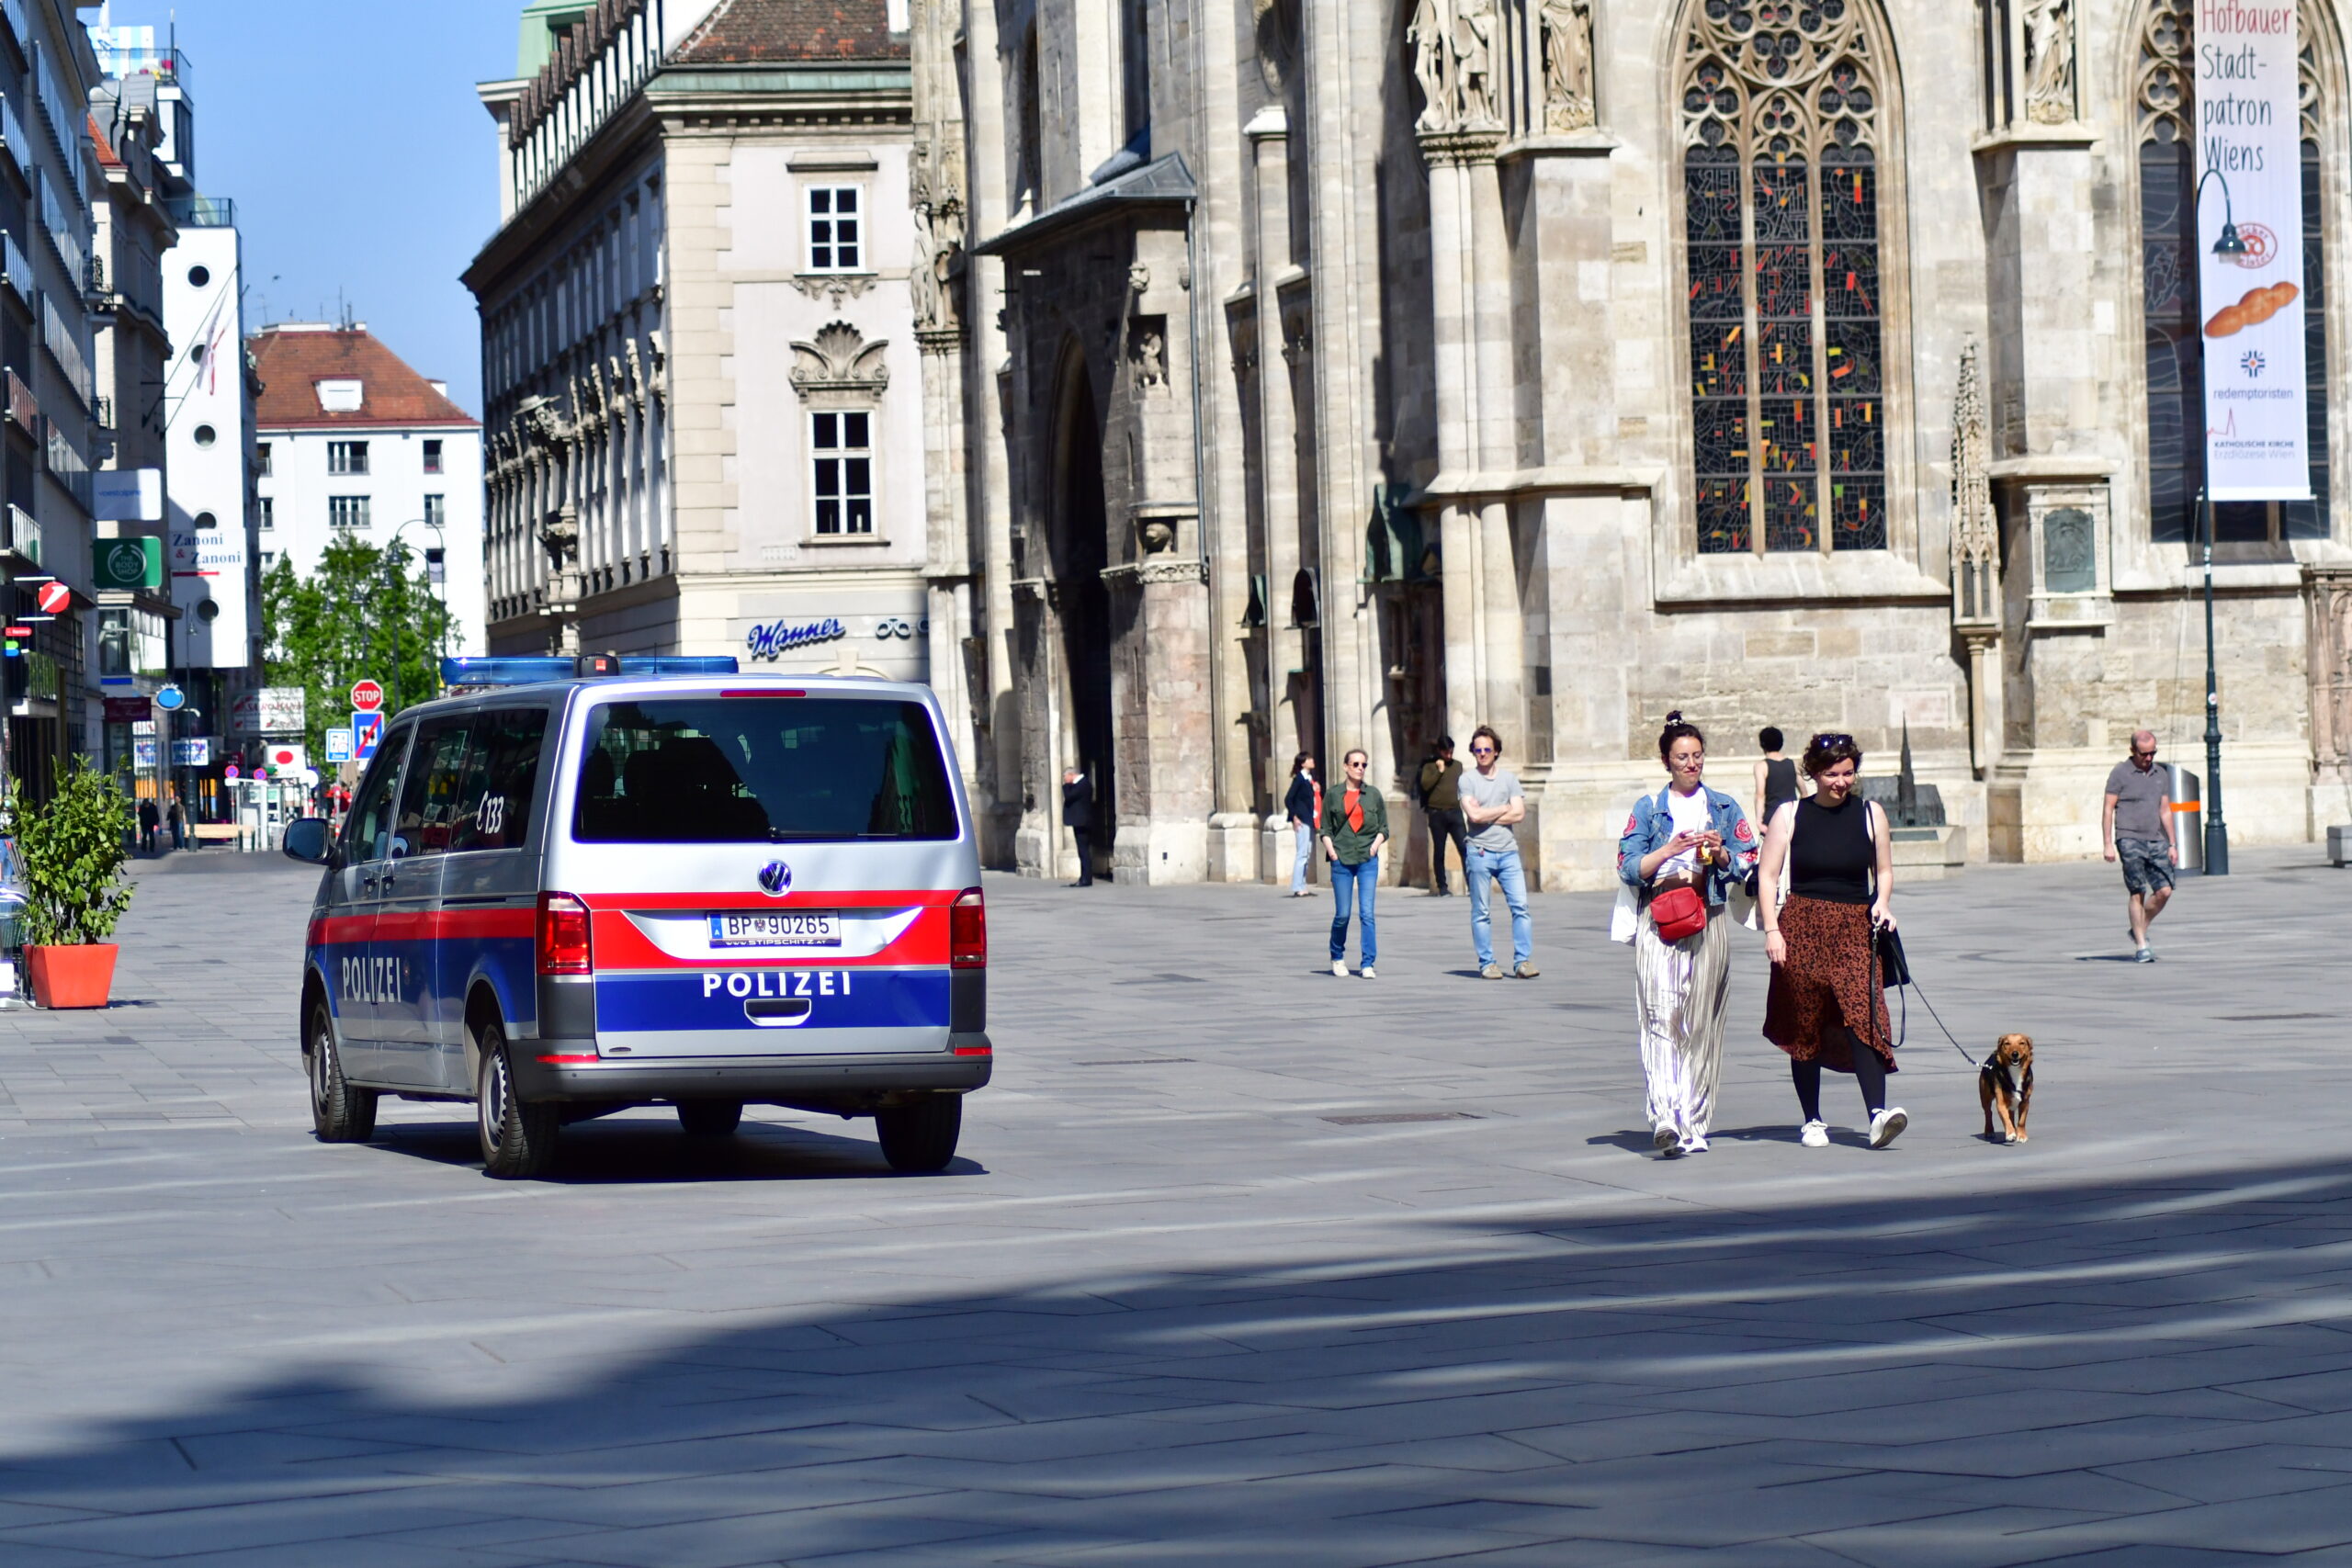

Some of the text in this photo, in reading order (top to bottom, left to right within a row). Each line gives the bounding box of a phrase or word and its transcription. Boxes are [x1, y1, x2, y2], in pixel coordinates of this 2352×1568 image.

[2201, 0, 2293, 35] Hofbauer
[2201, 43, 2267, 80] Stadt-
[2203, 92, 2272, 132] patron
[2203, 135, 2264, 173] Wiens
[2213, 387, 2294, 401] redemptoristen
[2267, 449, 2295, 459] Wien
[173, 533, 224, 547] Zanoni
[175, 548, 242, 565] & Zanoni
[746, 618, 845, 658] Manner
[355, 690, 379, 703] STOP
[484, 795, 504, 835] 133
[729, 915, 830, 935] BP 90265
[342, 956, 401, 1003] POLIZEI
[703, 971, 851, 998] POLIZEI
